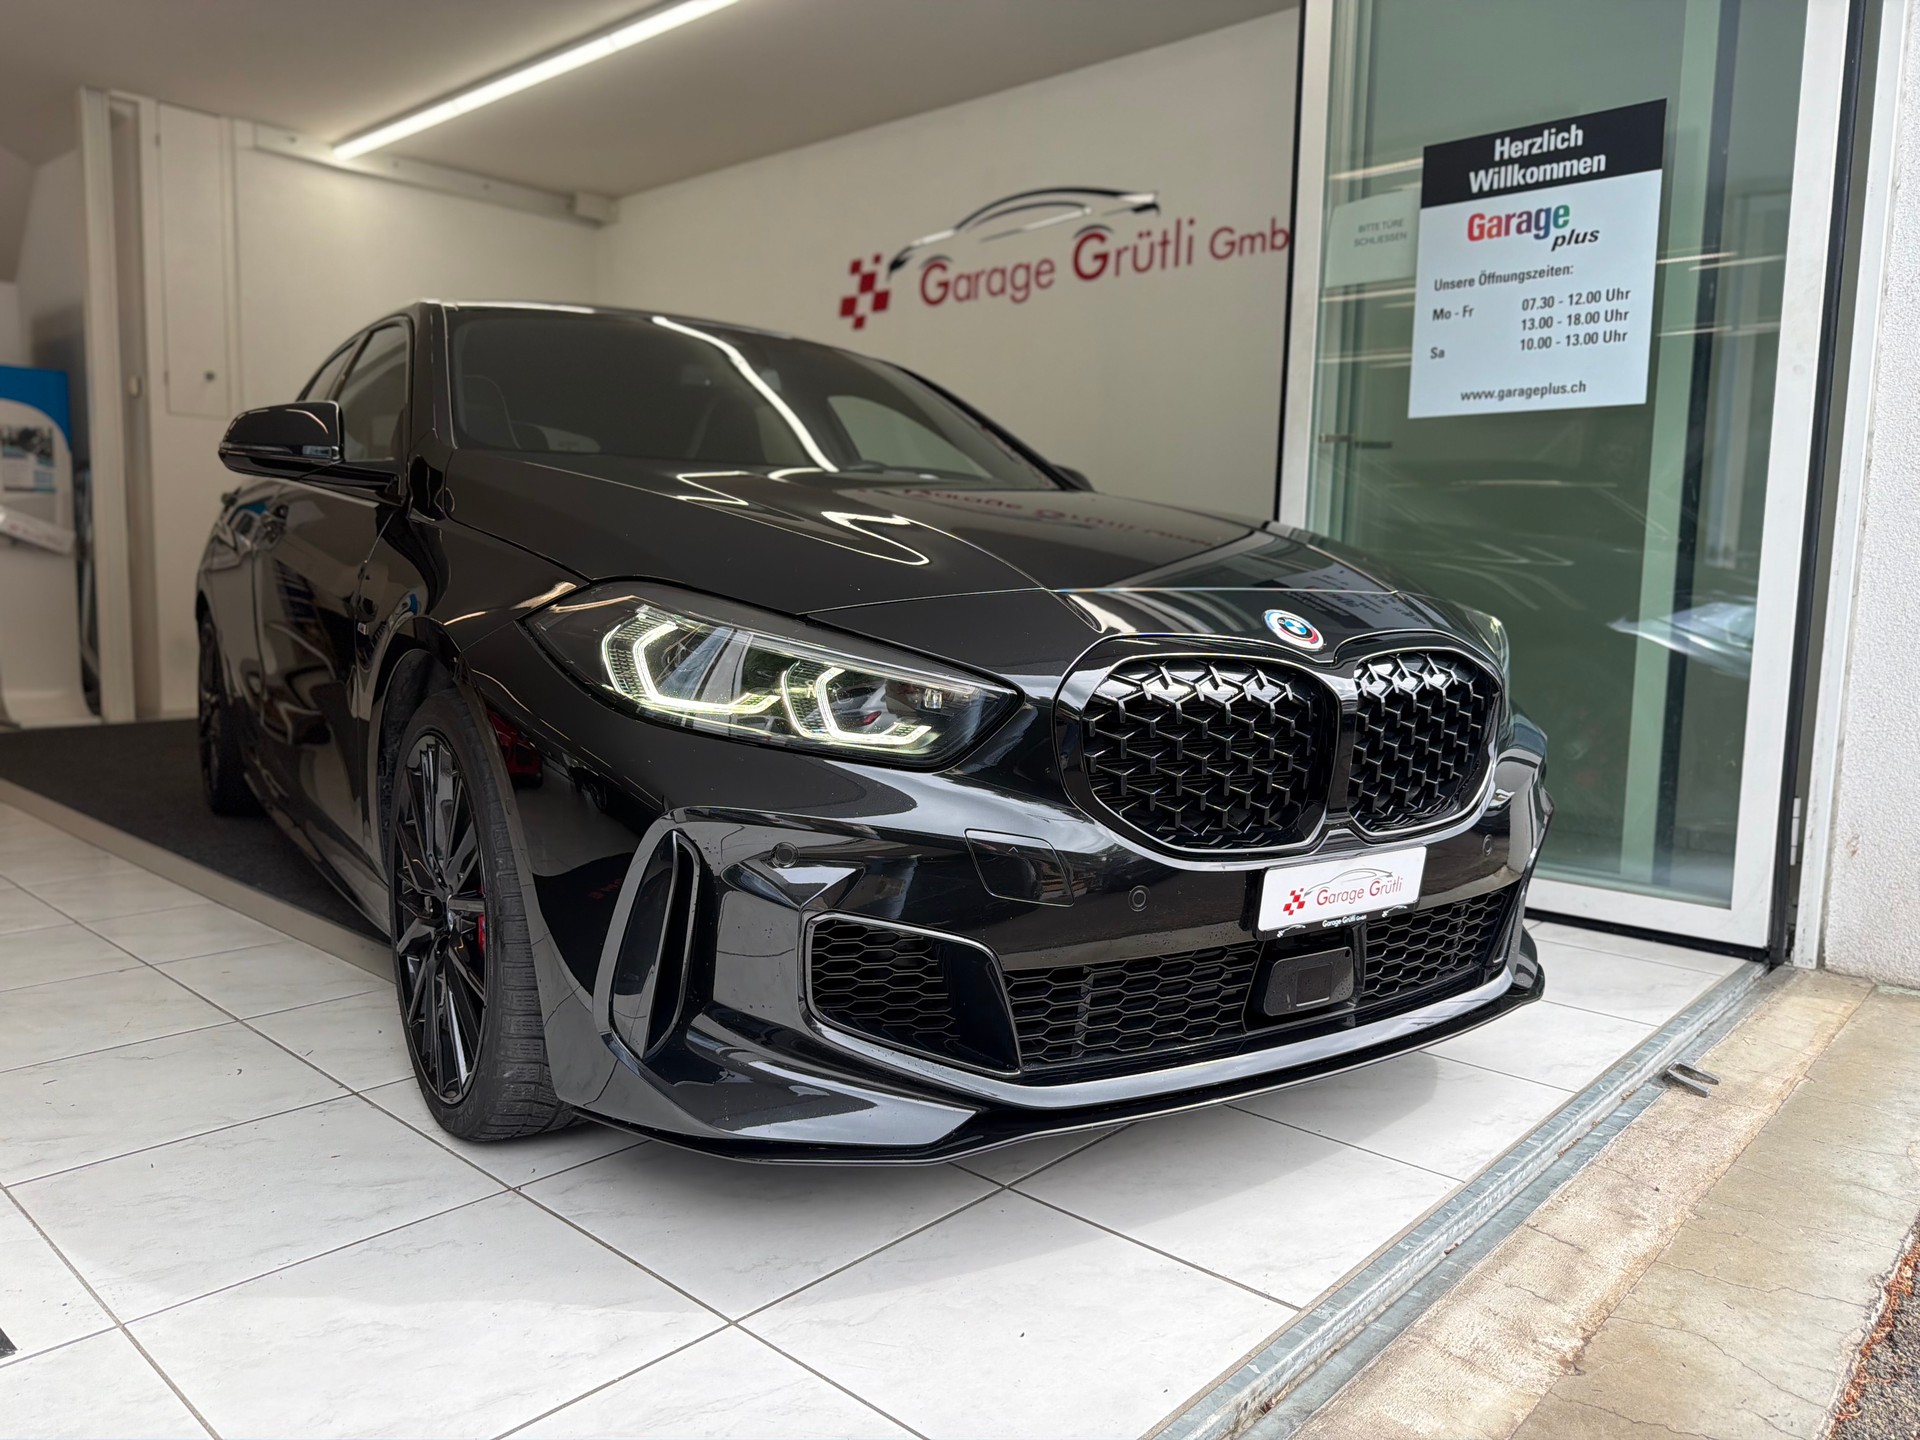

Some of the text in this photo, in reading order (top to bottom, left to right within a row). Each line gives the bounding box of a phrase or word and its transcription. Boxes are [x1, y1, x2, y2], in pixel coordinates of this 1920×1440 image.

[1494, 124, 1583, 161] Herzlich
[1469, 153, 1606, 193] Willkommen
[1358, 222, 1379, 233] BITTE
[1467, 202, 1569, 242] Garage
[1354, 232, 1407, 247] SCHLIESSEN
[1551, 227, 1600, 251] plus
[920, 216, 1290, 307] Garage Grütli Gmb
[1434, 264, 1574, 291] Unsere Öffnungszeiten:
[1522, 296, 1554, 311] 07.30
[1568, 291, 1601, 306] 12.00
[1606, 288, 1631, 302] Uhr
[1432, 308, 1452, 320] Mo
[1463, 305, 1474, 318] Fr
[1521, 316, 1553, 331] 13.00
[1567, 311, 1600, 326] 18.00
[1604, 309, 1629, 323] Uhr
[1520, 336, 1552, 351] 10.00
[1565, 332, 1598, 347] 13.00
[1602, 330, 1628, 344] Uhr
[1430, 346, 1445, 359] Sa
[1460, 380, 1586, 402] www.garageplus.ch
[1317, 877, 1403, 906] Garage Grütli
[1322, 919, 1341, 927] Garage
